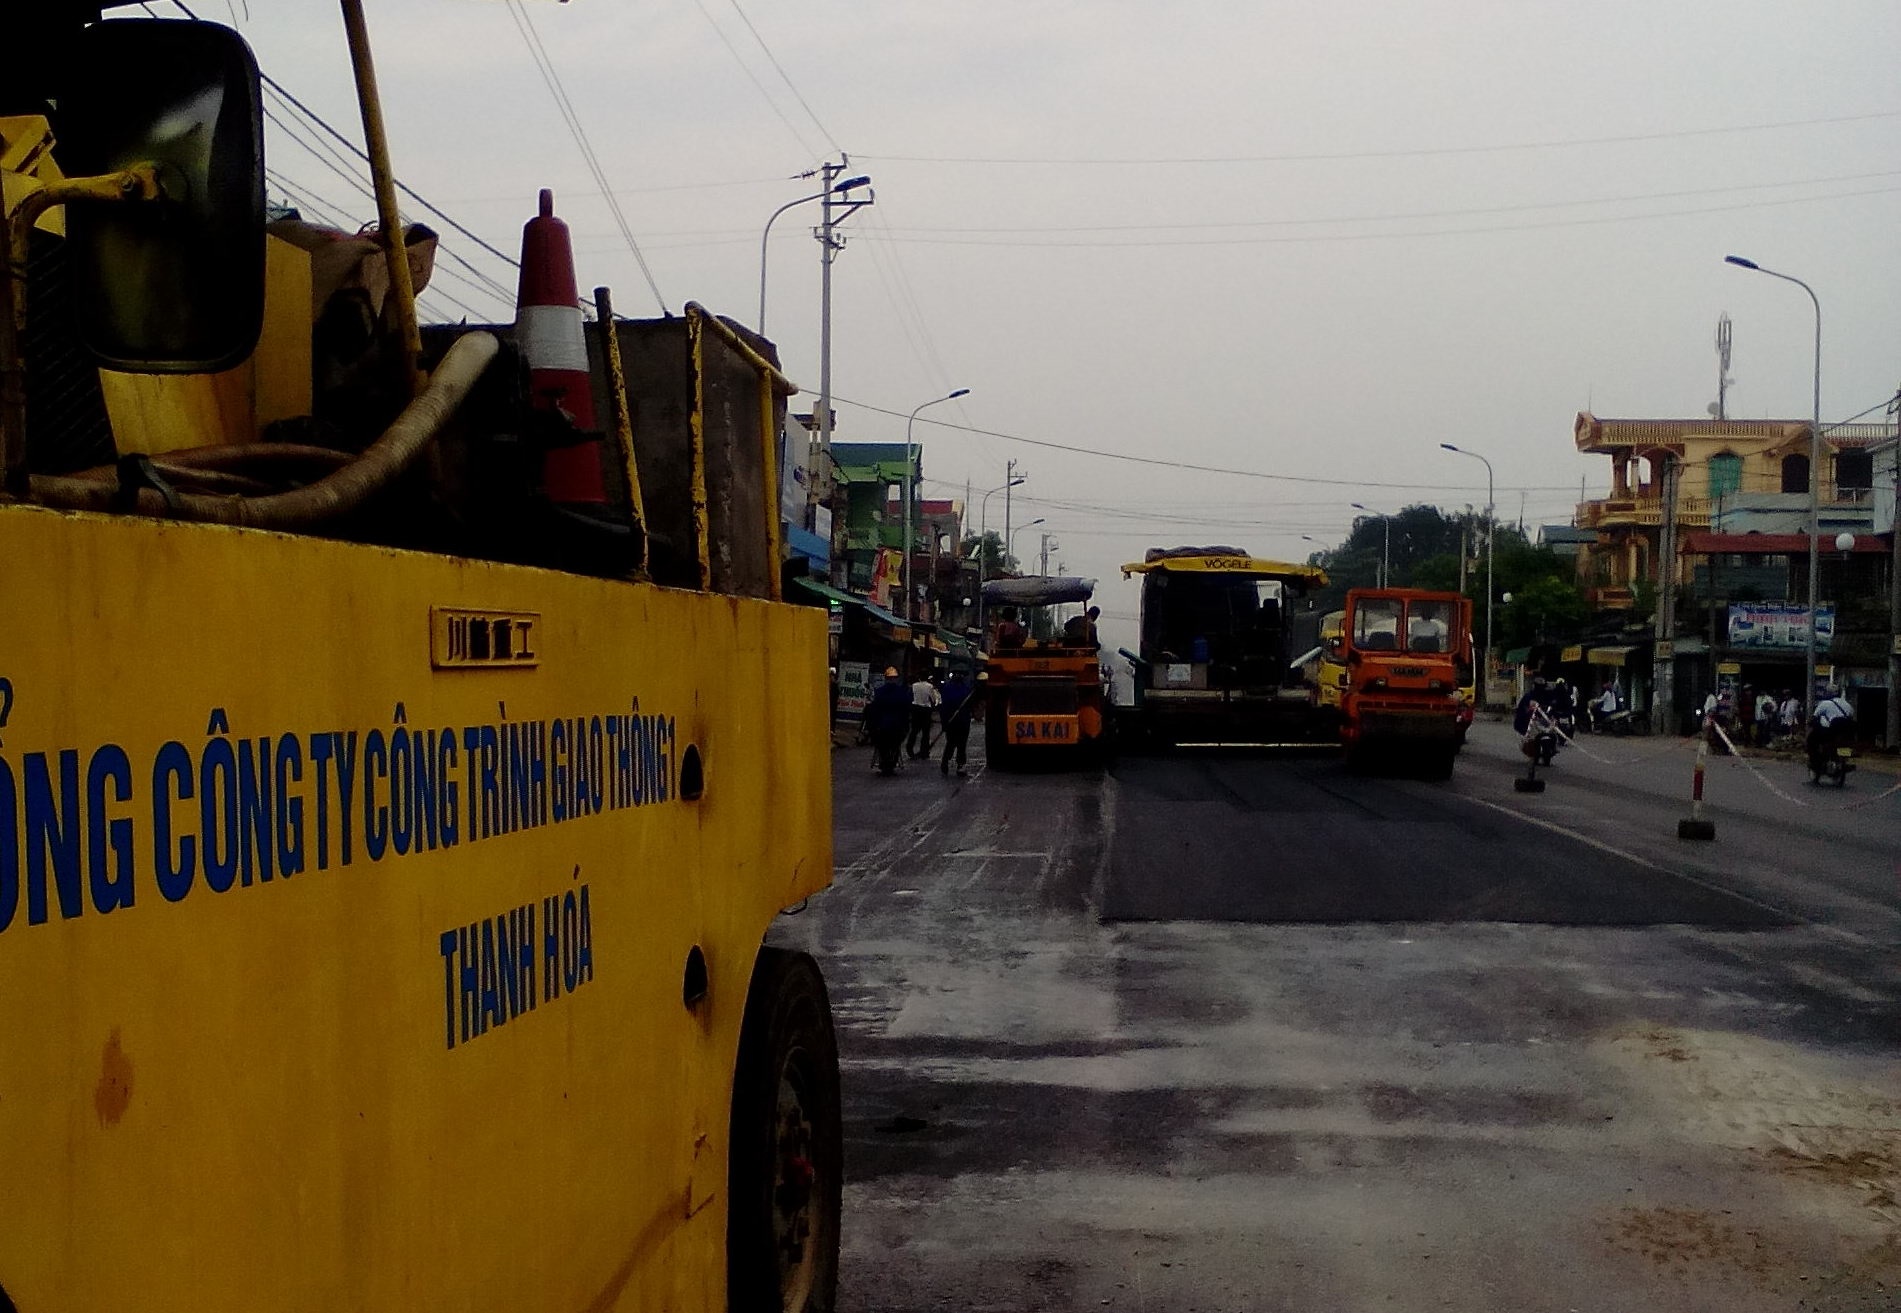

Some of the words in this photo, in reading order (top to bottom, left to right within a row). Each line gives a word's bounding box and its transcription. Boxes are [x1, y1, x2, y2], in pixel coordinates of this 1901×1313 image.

[153, 708, 304, 902] CÔNG
[310, 731, 357, 870] TY
[364, 702, 458, 861] CÔNG
[464, 701, 547, 842] TRÌNH
[551, 715, 603, 823] GIAO
[441, 903, 536, 1049] THANH
